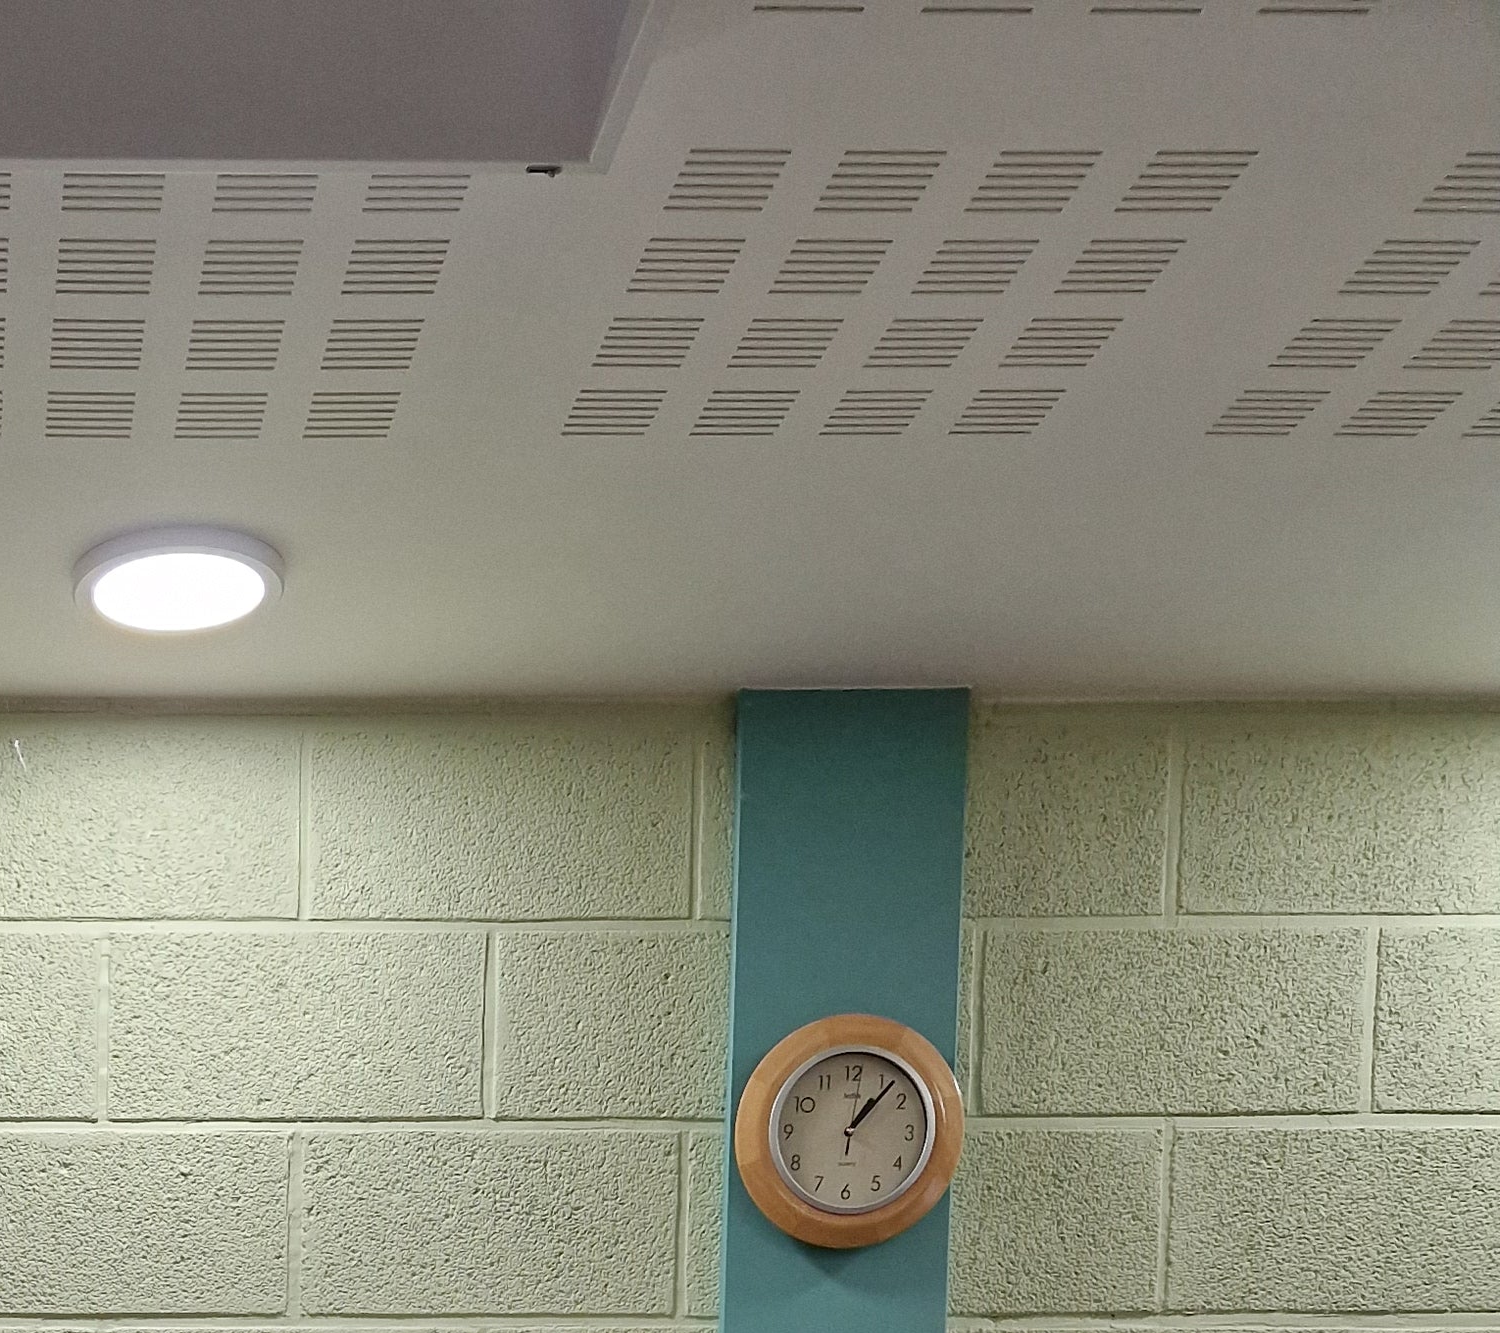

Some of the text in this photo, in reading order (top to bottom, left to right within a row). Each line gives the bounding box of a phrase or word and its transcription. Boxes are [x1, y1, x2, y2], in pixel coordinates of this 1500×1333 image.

[844, 1065, 862, 1081] 12
[879, 1074, 884, 1089] 1
[818, 1074, 831, 1091] 11
[794, 1096, 815, 1113] 10
[896, 1093, 907, 1110] 2
[783, 1124, 793, 1140] 9
[904, 1124, 915, 1141] 3
[790, 1154, 801, 1171] 8
[892, 1155, 902, 1171] 4
[814, 1175, 824, 1192] 7
[840, 1183, 850, 1200] 6
[870, 1175, 881, 1191] 5
